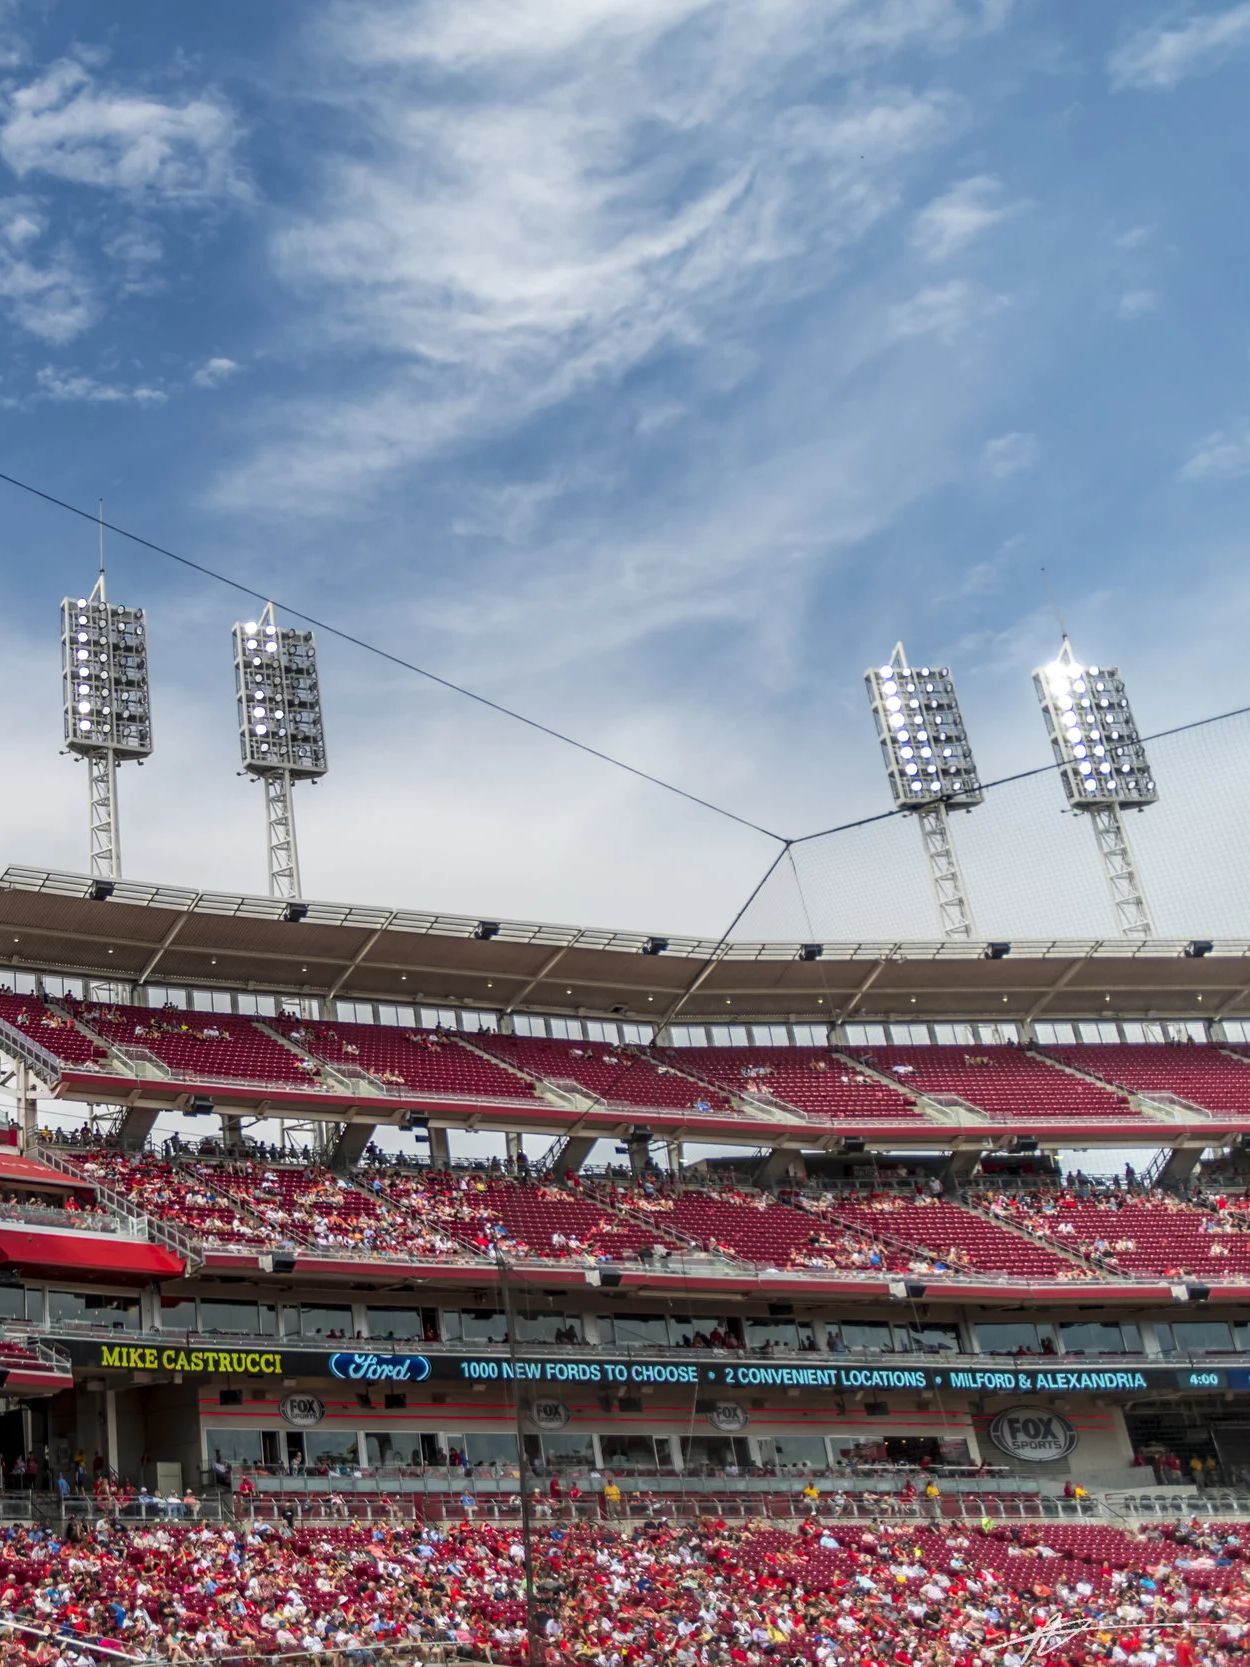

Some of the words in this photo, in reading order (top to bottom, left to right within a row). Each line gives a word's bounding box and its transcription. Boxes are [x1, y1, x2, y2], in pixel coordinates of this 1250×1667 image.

[101, 1346, 158, 1369] MIKE
[162, 1350, 282, 1374] CASTRUCCI
[349, 1354, 411, 1380] Ford
[460, 1362, 499, 1379] 1000
[501, 1362, 541, 1380] NEW
[545, 1363, 600, 1381] FORDS
[604, 1364, 628, 1381] TO
[631, 1365, 698, 1382] CHOOSE
[725, 1368, 735, 1384] 2
[737, 1368, 837, 1385] CONVENIENT
[841, 1370, 926, 1387] LOCATIONS
[950, 1372, 1016, 1389] MILFORD
[1018, 1374, 1032, 1389] &
[1036, 1373, 1147, 1390] ALEXANDRIA
[1190, 1374, 1218, 1385] 4:00
[290, 1399, 316, 1413] FOX
[536, 1403, 562, 1417] FOX
[716, 1406, 740, 1419] FOX
[1007, 1417, 1059, 1440] FOX
[1012, 1440, 1062, 1450] SPORTS
